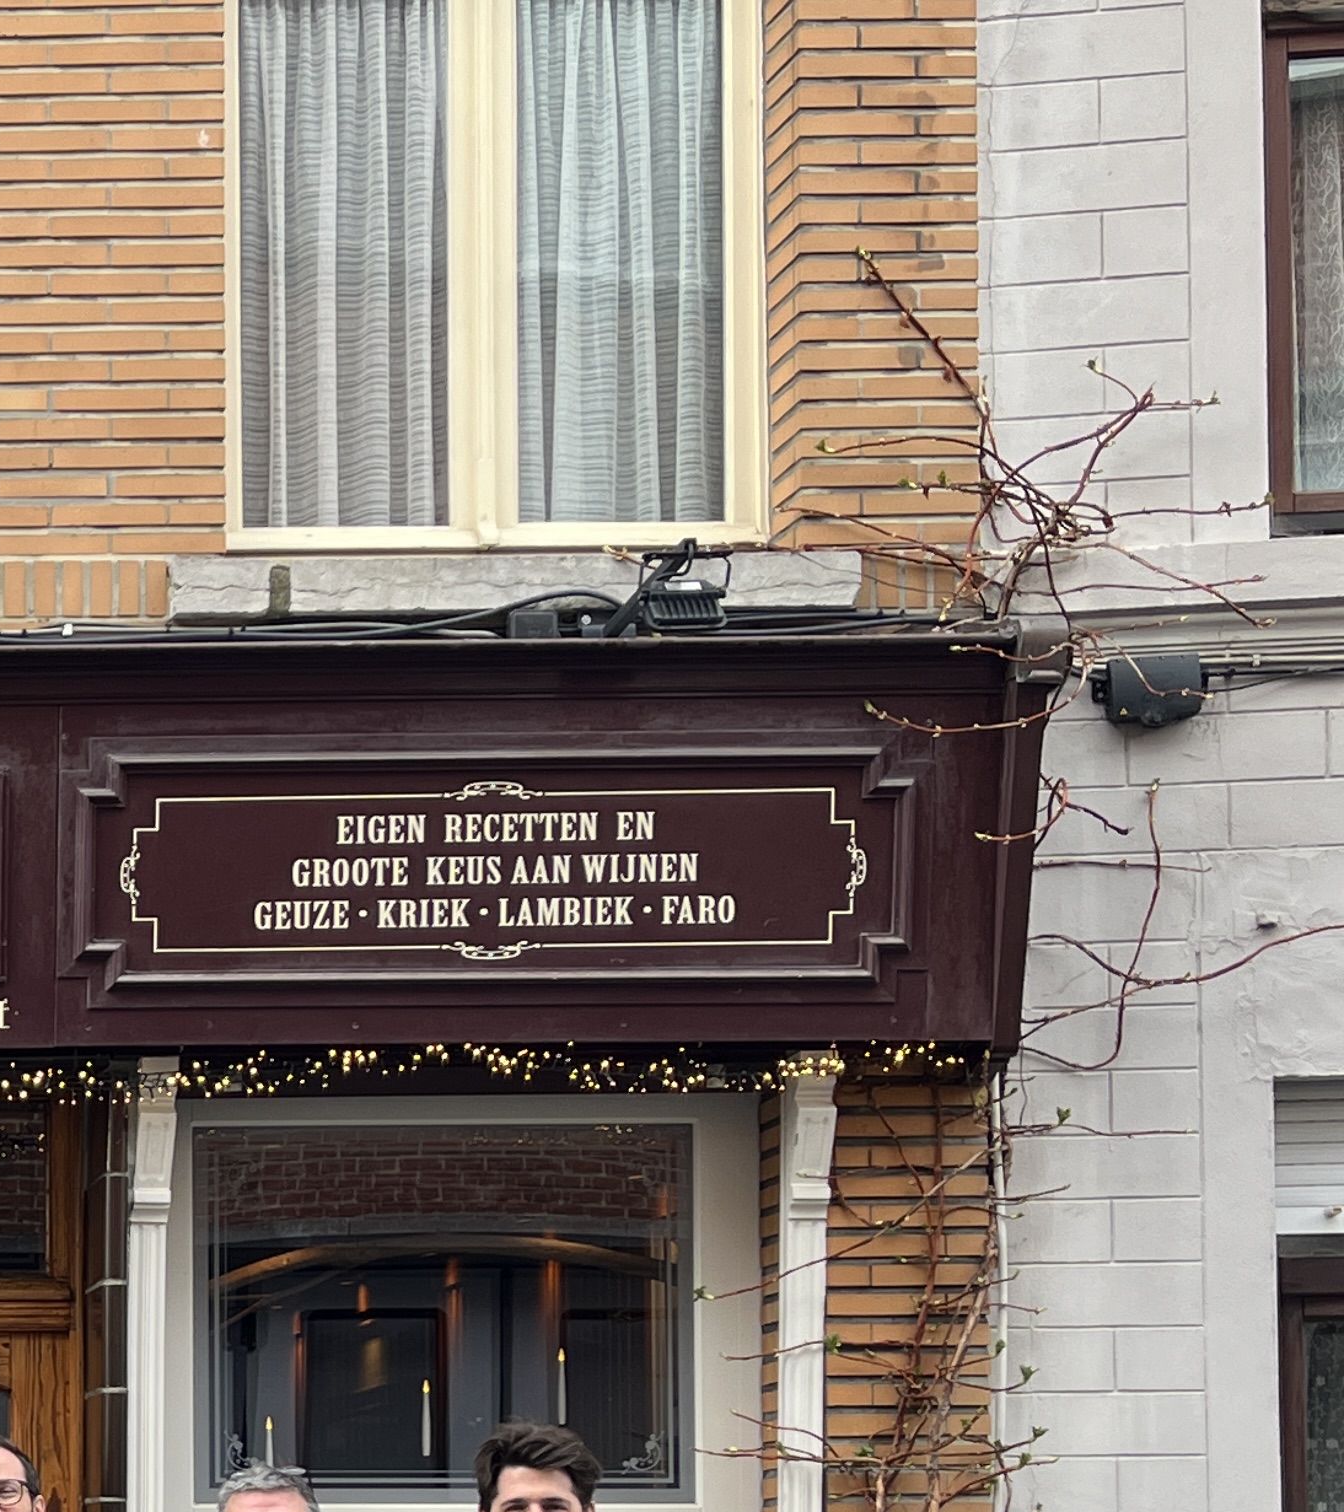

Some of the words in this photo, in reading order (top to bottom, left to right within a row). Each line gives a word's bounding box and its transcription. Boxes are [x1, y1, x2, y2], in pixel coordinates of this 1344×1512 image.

[336, 814, 427, 845] EIGEN
[443, 811, 599, 844] RECETTEN
[616, 811, 656, 841] EN
[291, 856, 409, 888] GROOTE
[425, 855, 502, 886] KEUS
[510, 854, 572, 885] AAN
[581, 853, 699, 884] WIJNEN
[254, 900, 350, 931] GEUZE
[376, 898, 471, 929] KRIEK
[498, 895, 635, 927] LAMBIEK
[661, 894, 736, 925] FARO
